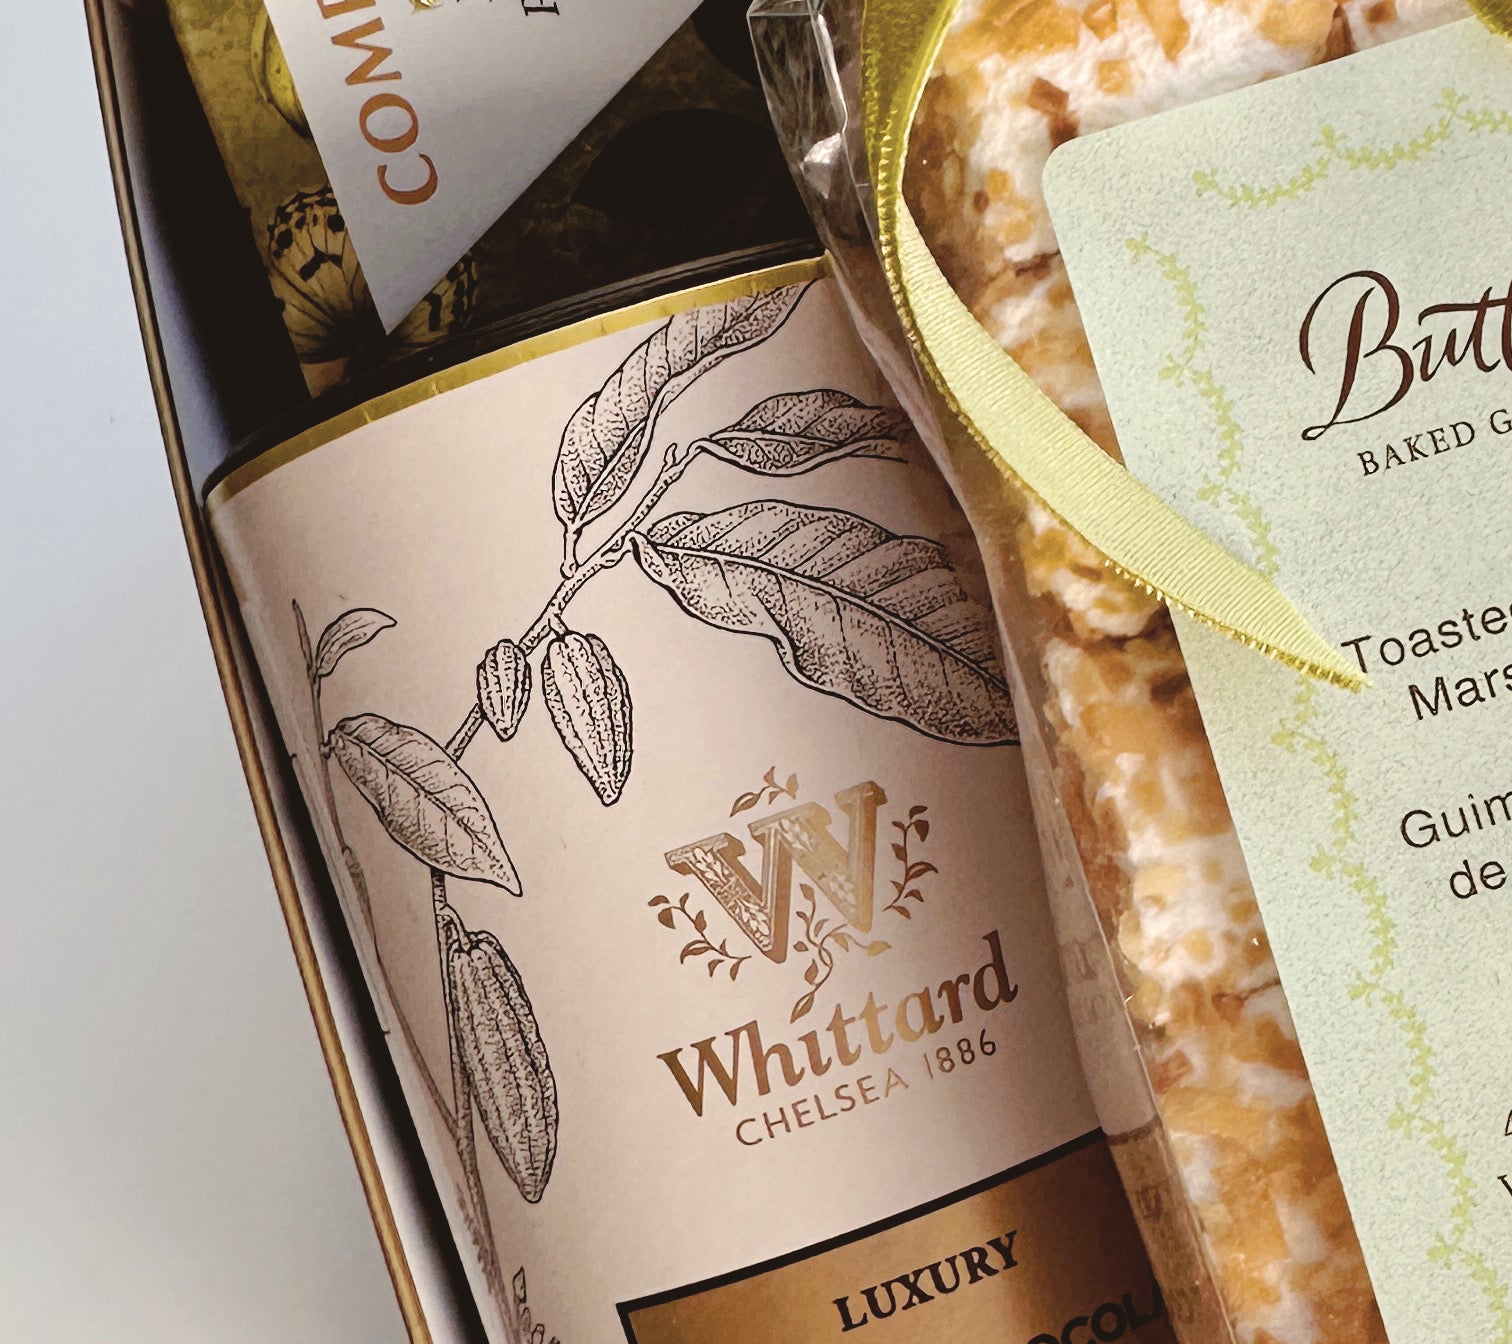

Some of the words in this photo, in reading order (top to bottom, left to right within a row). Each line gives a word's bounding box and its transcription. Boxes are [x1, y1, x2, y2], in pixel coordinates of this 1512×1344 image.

[1357, 420, 1475, 476] BAKED
[1449, 857, 1508, 900] de
[656, 931, 1019, 1118] Whittard
[735, 1067, 908, 1147] CHELSEA
[924, 1028, 997, 1081] 1886
[832, 1231, 1019, 1333] LUXURY
